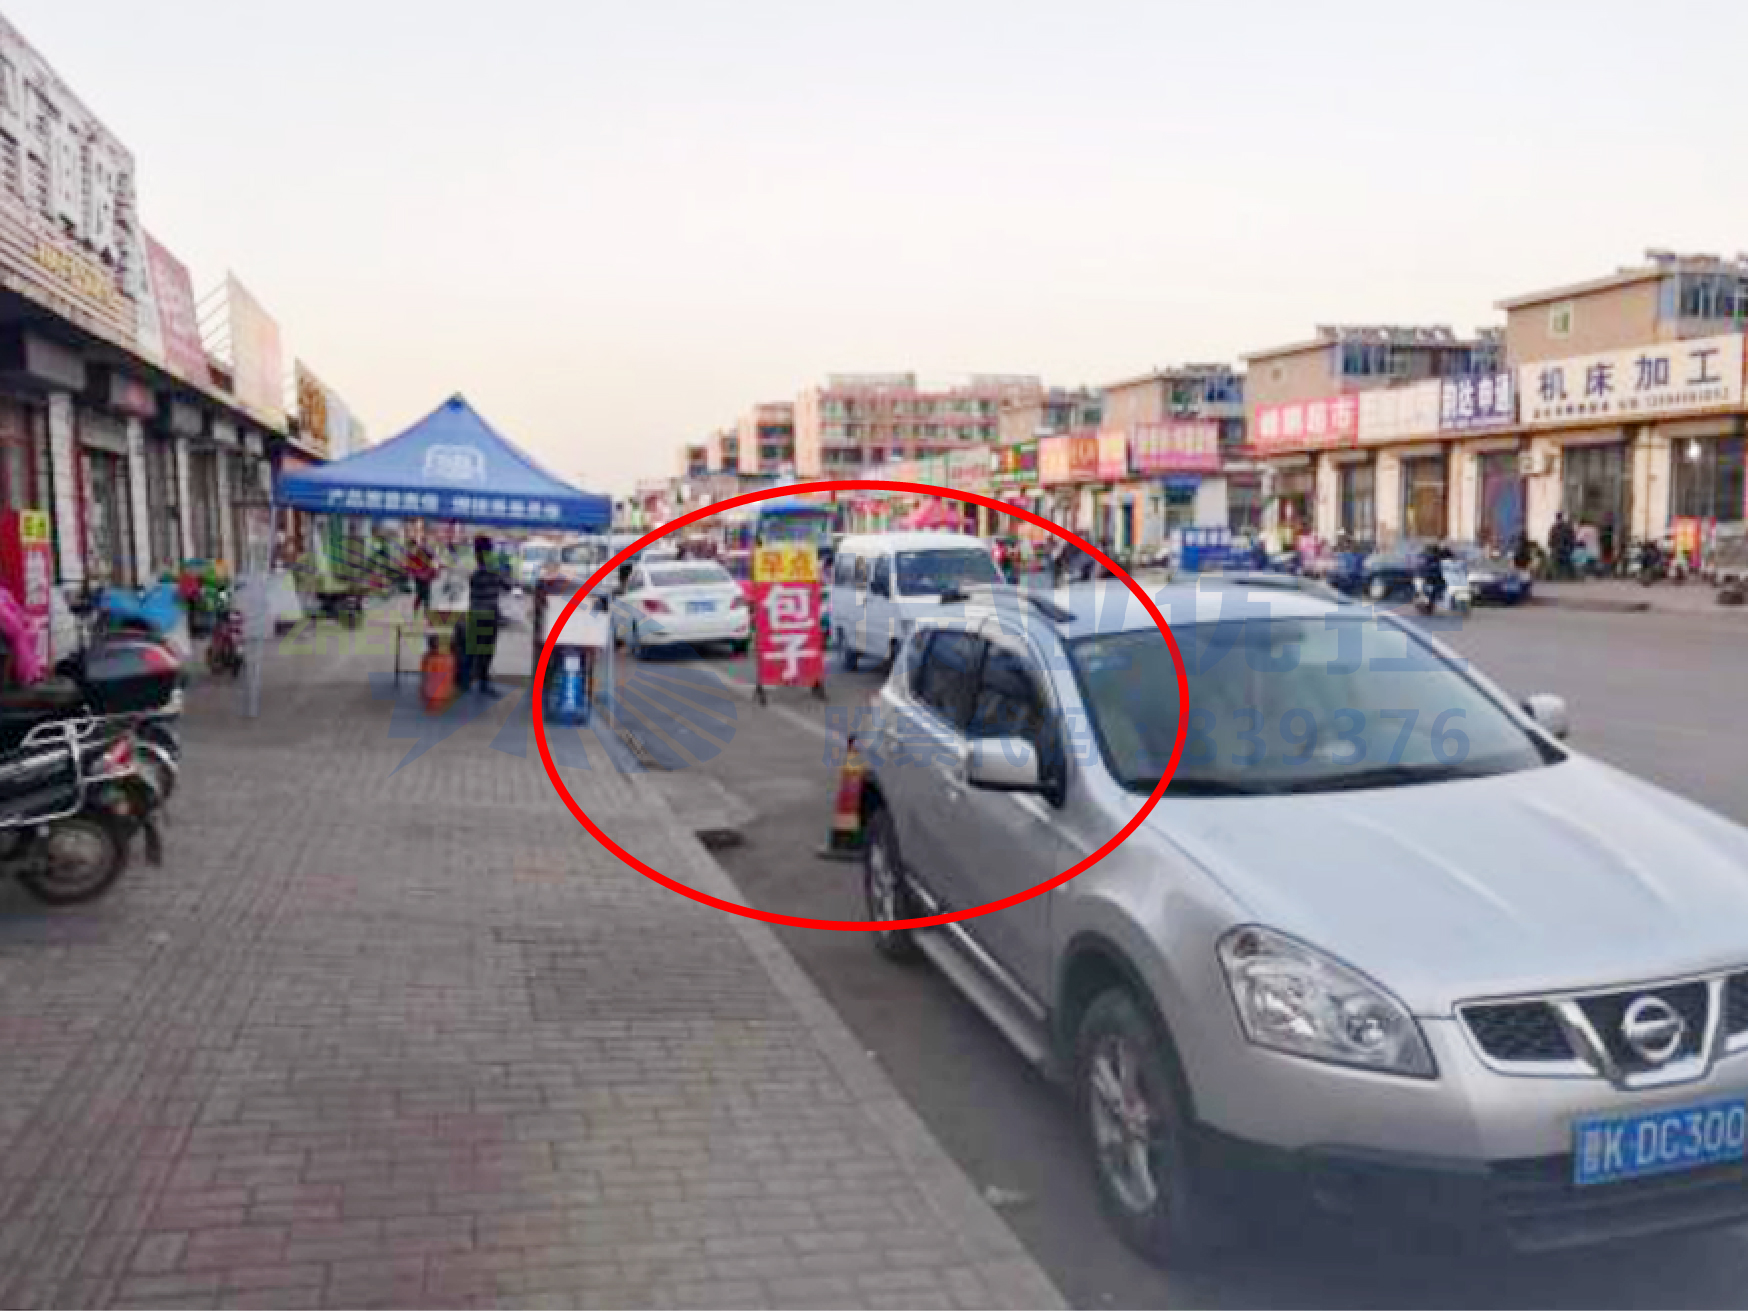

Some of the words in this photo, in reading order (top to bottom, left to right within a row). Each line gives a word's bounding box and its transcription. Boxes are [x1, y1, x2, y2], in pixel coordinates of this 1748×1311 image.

[1537, 347, 1722, 400] 机床加工
[760, 584, 819, 682] 包子
